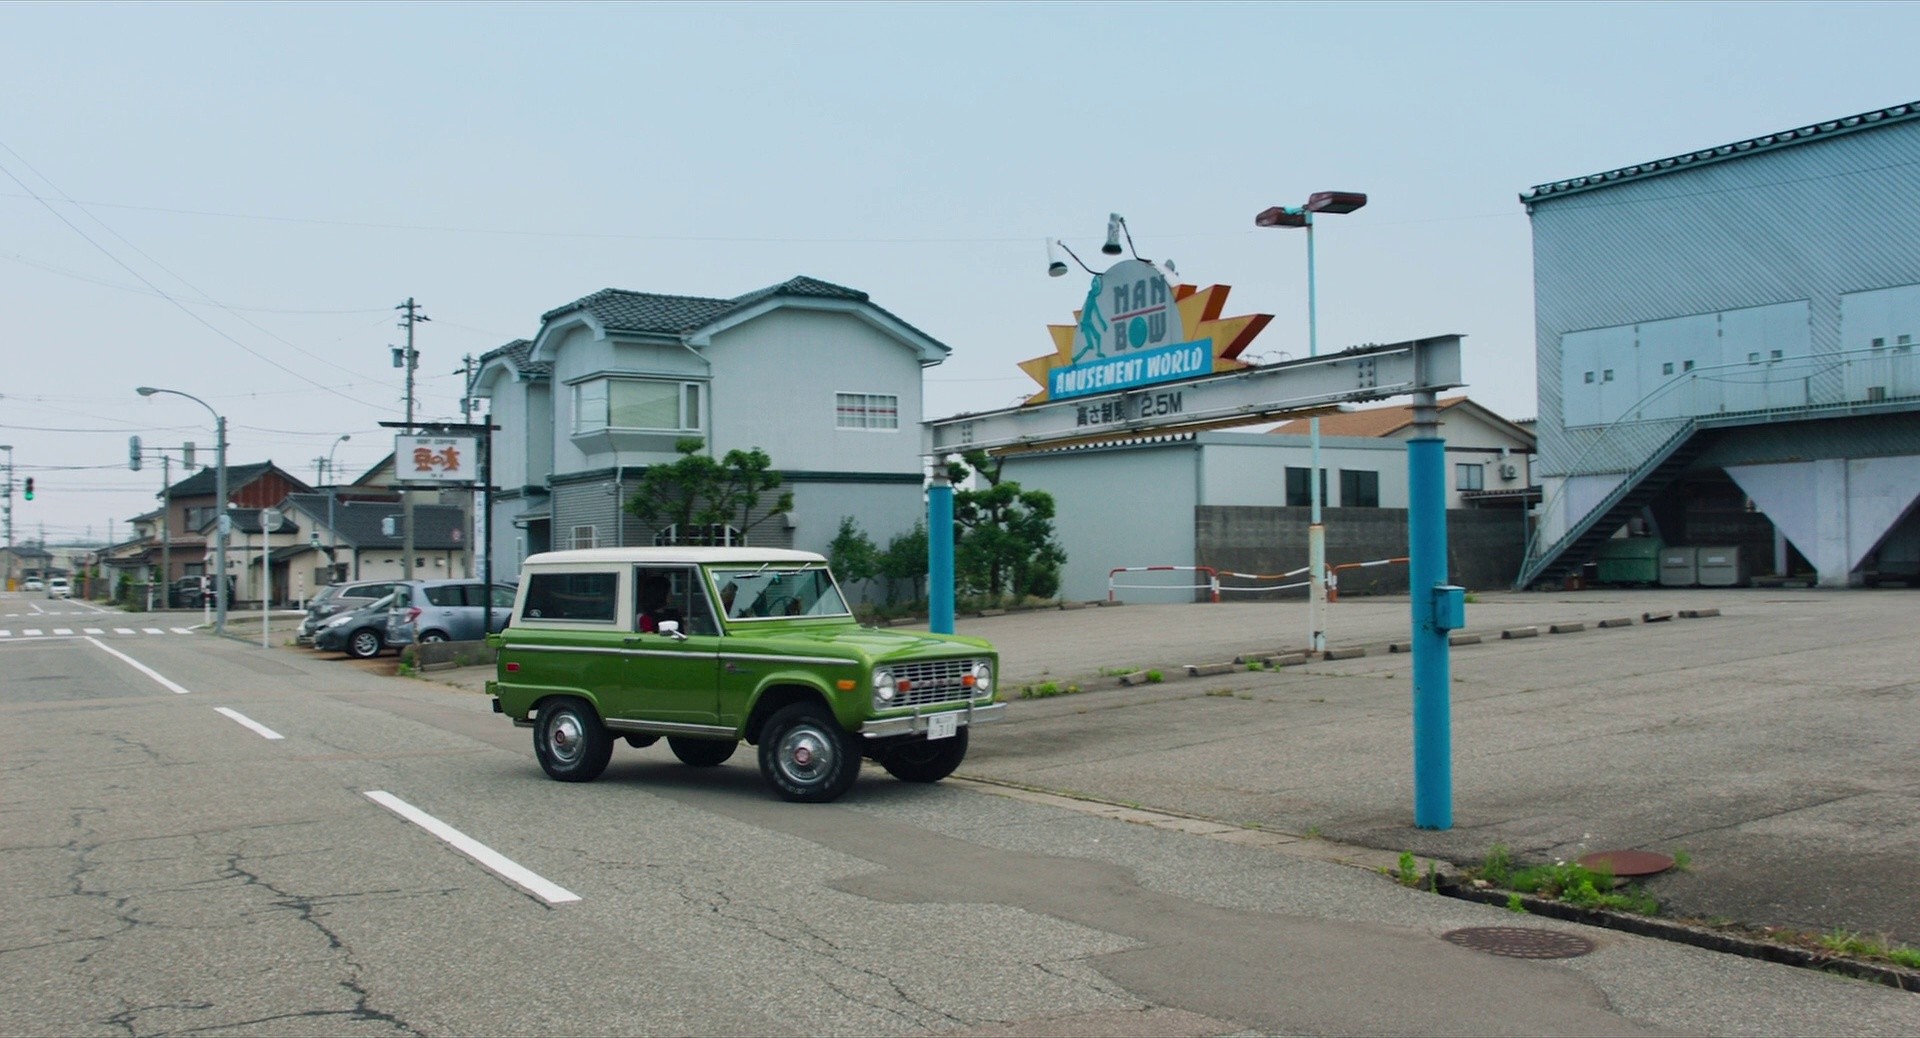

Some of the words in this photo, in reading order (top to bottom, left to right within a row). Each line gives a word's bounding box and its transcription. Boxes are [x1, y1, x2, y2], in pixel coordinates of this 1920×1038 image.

[1114, 274, 1166, 314] MAN
[1114, 312, 1166, 351] BOW
[1055, 358, 1143, 394] AMUSEMENT
[1148, 347, 1202, 377] WORLD
[1077, 401, 1126, 427] 高さ制限
[1141, 391, 1182, 418] 2.5M
